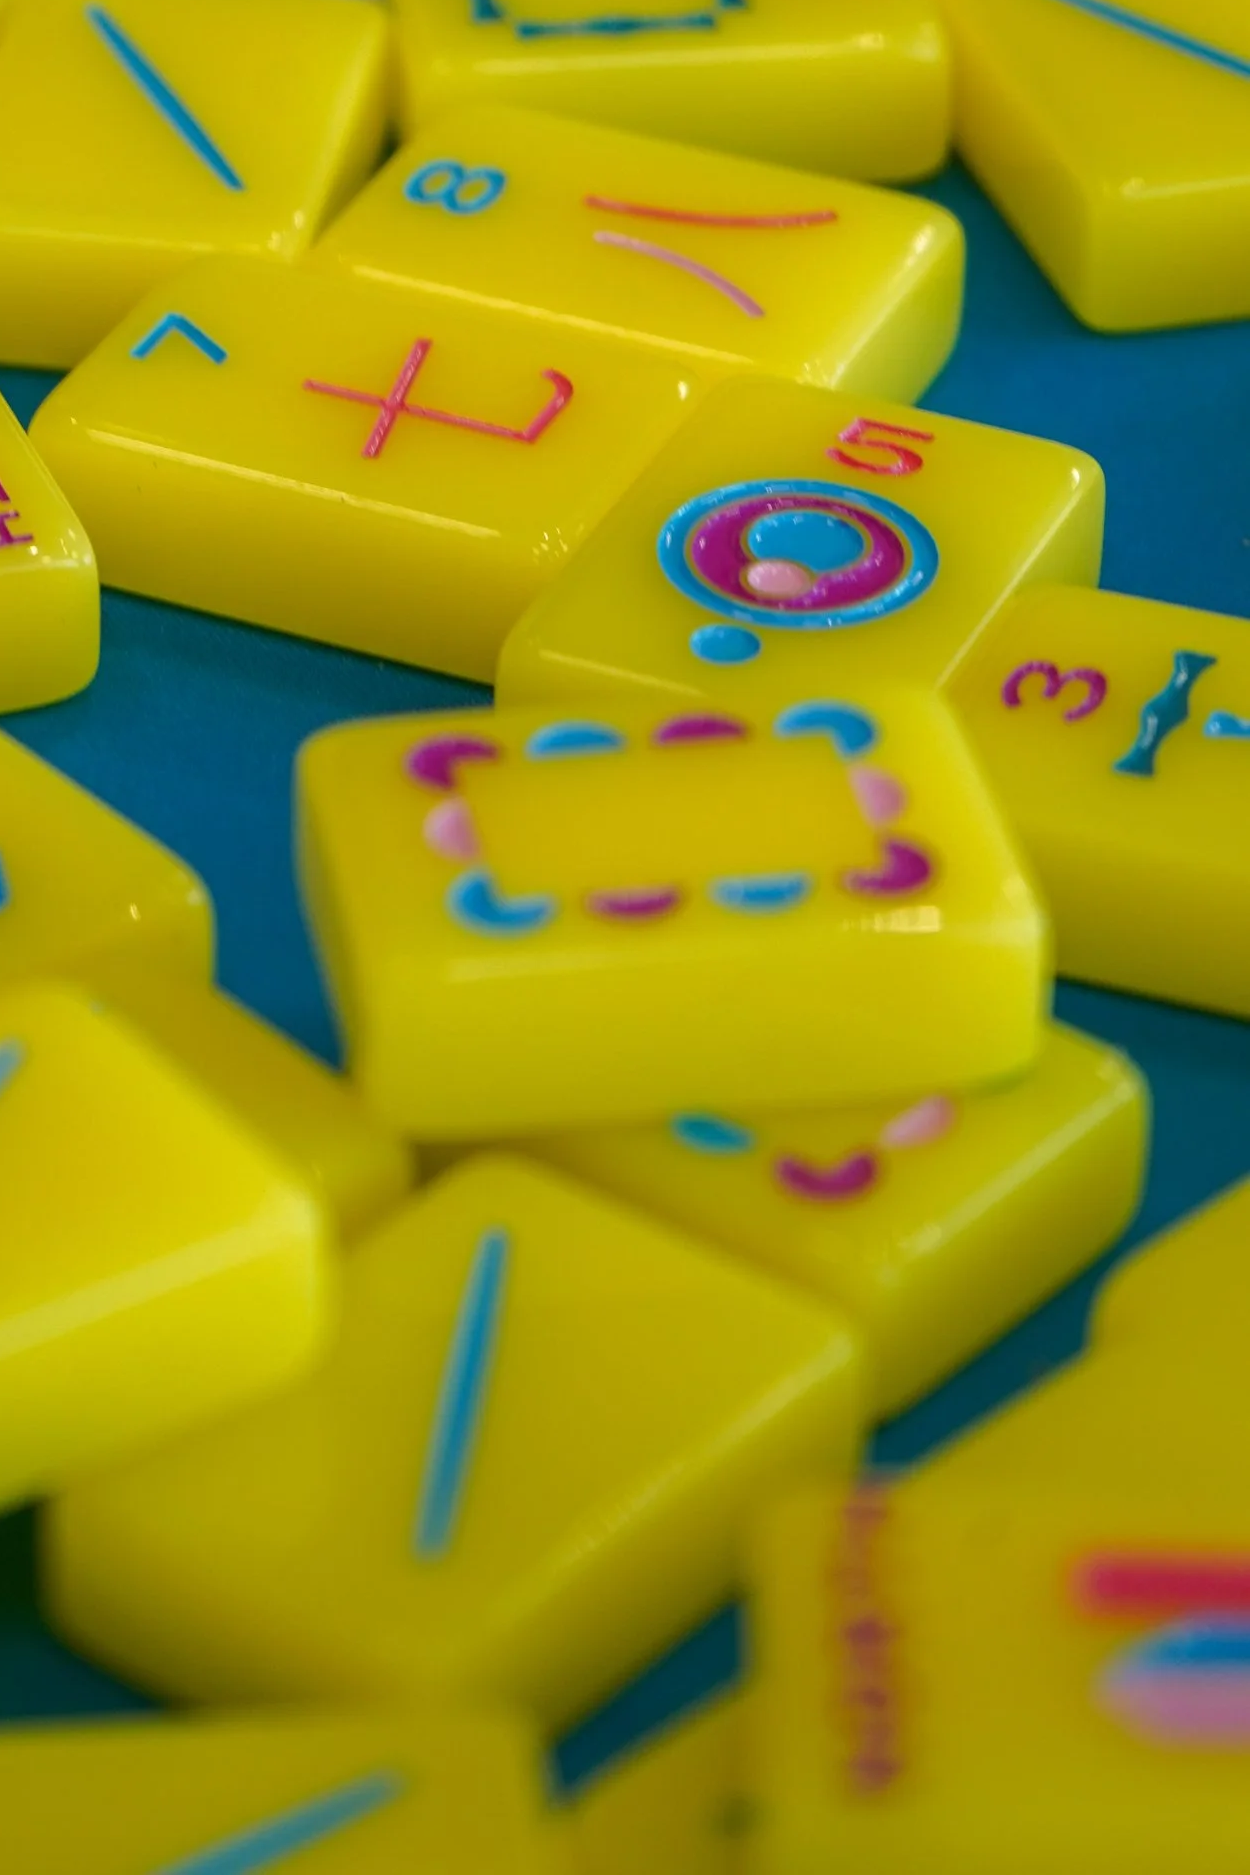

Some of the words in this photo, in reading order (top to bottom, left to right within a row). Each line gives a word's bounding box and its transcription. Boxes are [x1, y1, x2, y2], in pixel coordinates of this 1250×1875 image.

[402, 158, 508, 216] 8
[129, 311, 229, 366] 7
[825, 416, 936, 477] 5
[1001, 659, 1108, 725] 3
